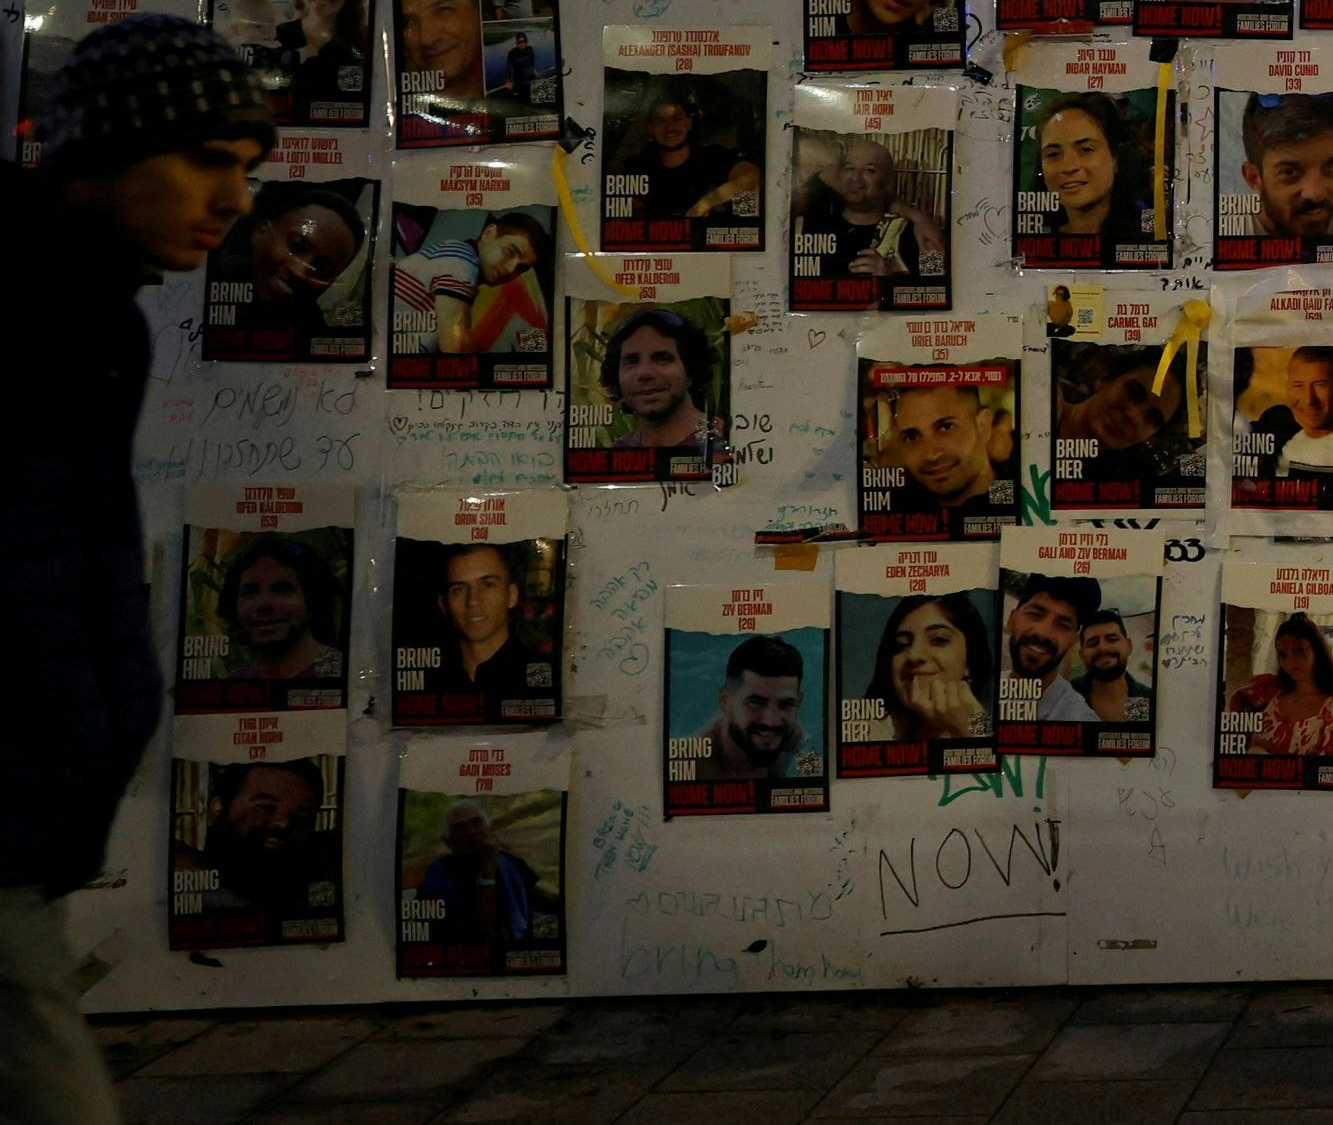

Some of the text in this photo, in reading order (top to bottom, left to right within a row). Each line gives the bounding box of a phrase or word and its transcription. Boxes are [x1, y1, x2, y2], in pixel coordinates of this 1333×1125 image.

[1108, 317, 1157, 328] CARMEL GAT
[1125, 329, 1141, 341] (39)
[886, 565, 949, 578] EDEN ZECHARYA
[910, 579, 926, 592] (28)
[1270, 582, 1333, 595] DANIELA GILBOA
[1294, 596, 1309, 609] (19)
[397, 647, 440, 668] BRING
[397, 671, 424, 691] HIM
[879, 819, 1061, 920] NOW!
